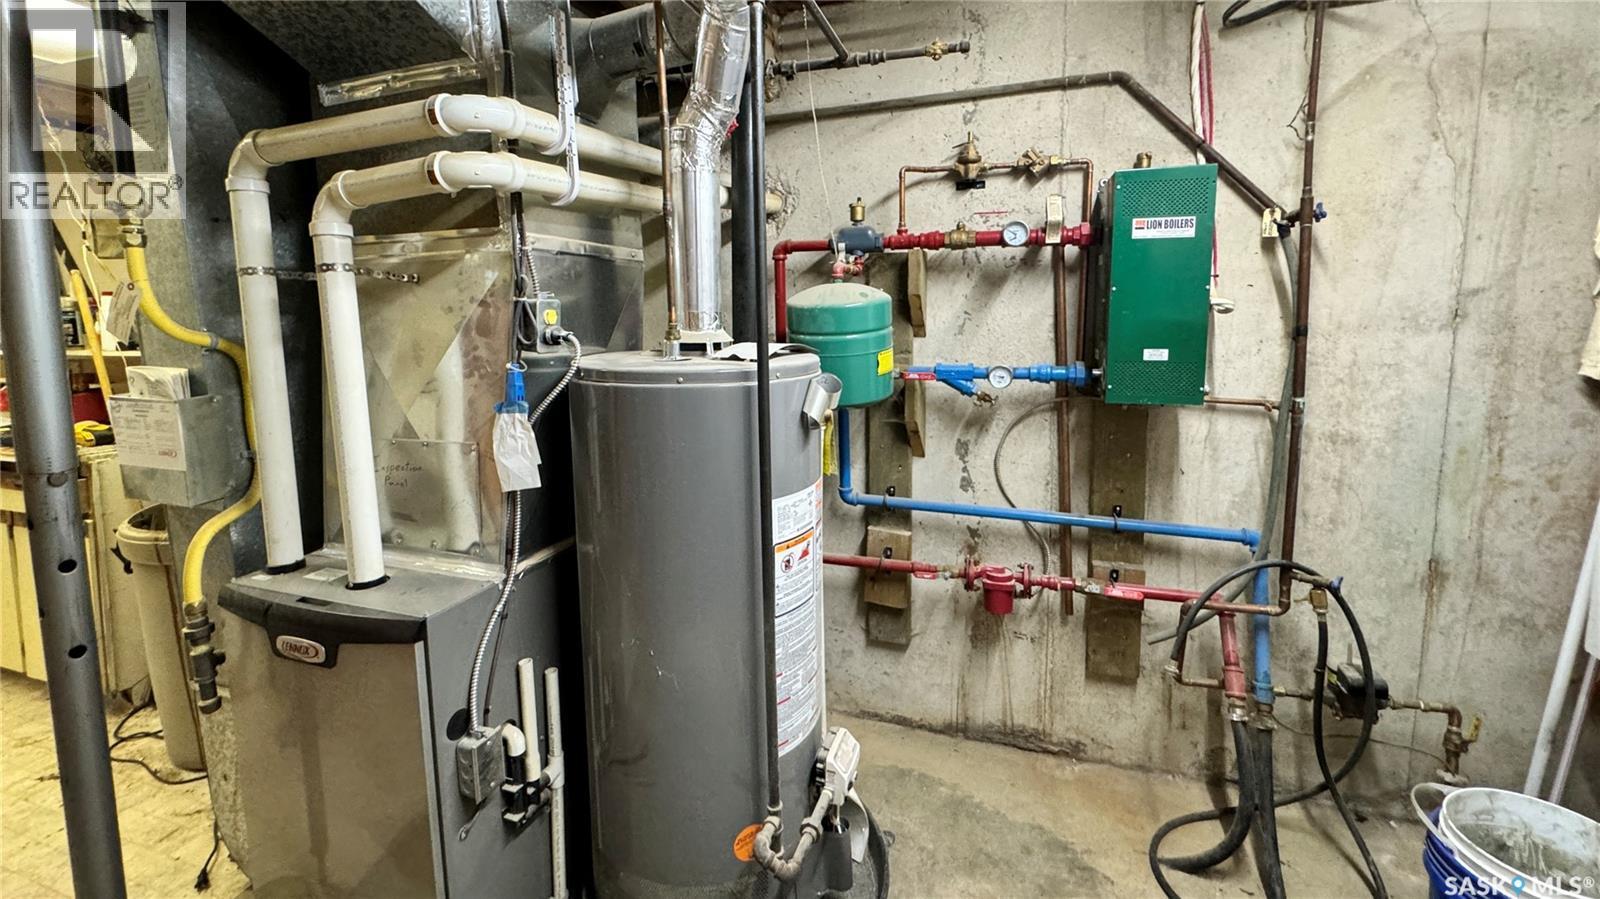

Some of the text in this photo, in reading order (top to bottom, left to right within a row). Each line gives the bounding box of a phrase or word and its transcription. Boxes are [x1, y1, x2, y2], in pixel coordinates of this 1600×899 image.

[1146, 219, 1163, 231] LION
[1163, 218, 1195, 230] BOILERS
[281, 640, 314, 657] LENNOX
